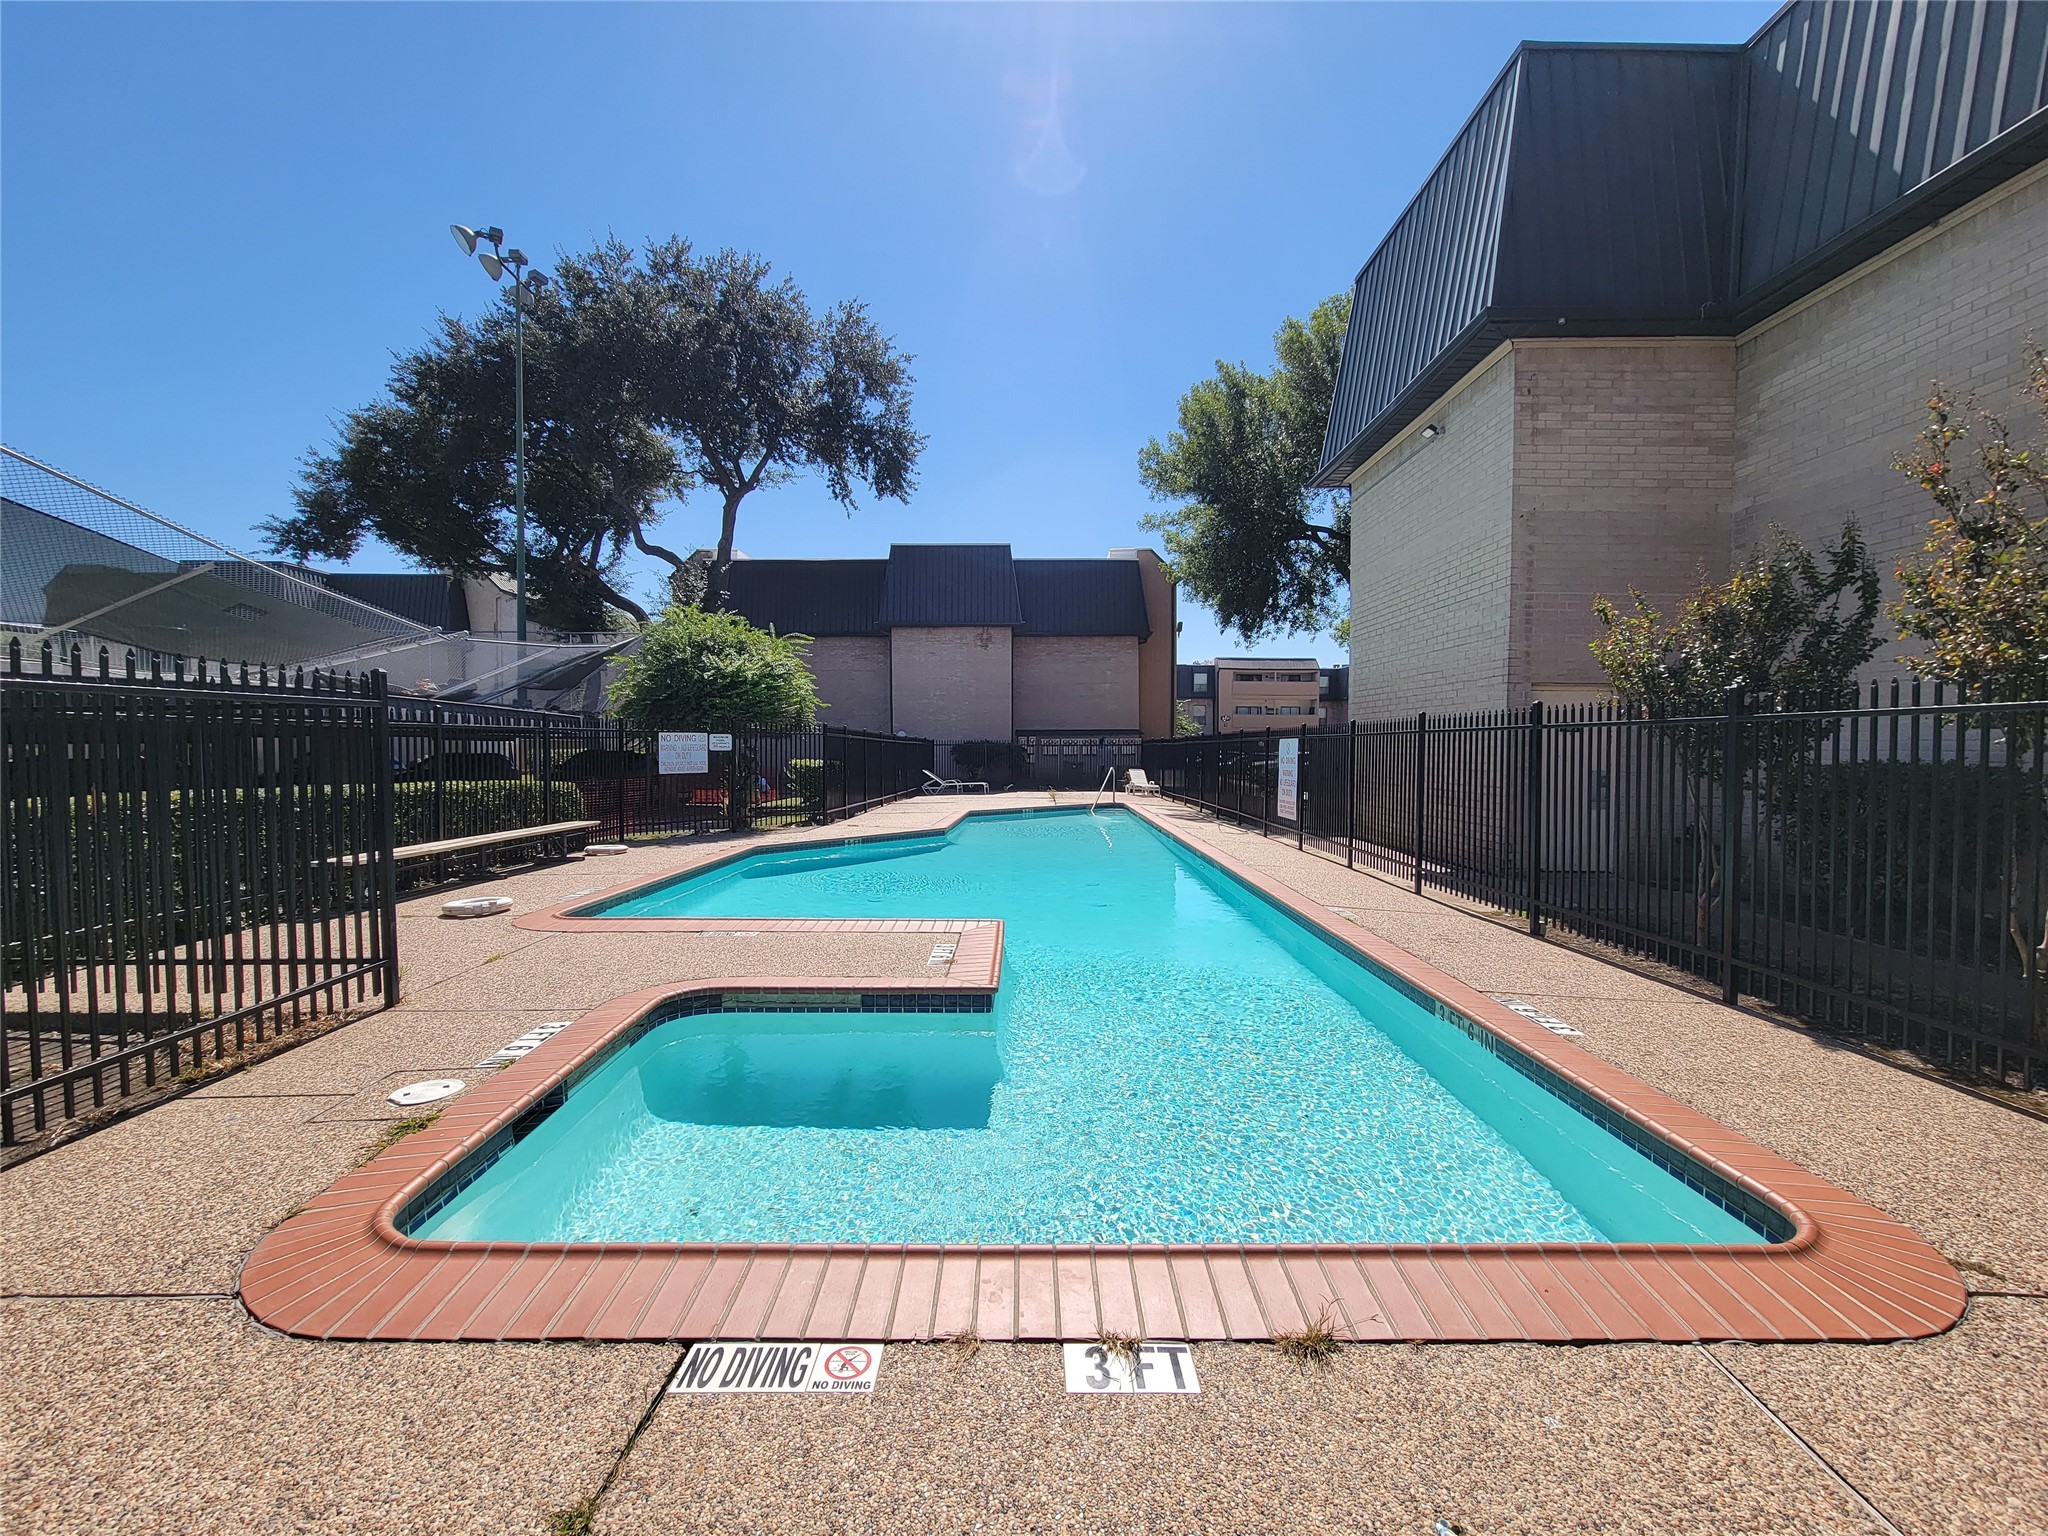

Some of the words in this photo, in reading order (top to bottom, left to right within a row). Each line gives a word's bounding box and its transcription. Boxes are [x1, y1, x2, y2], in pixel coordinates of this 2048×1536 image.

[519, 1032, 556, 1042] FT
[1480, 1030, 1494, 1054] IN
[676, 1347, 724, 1388] NO
[718, 1347, 812, 1388] DIVING
[1085, 1346, 1111, 1389] 3
[1132, 1347, 1188, 1389] FT
[811, 1381, 828, 1390] NO
[831, 1381, 871, 1390] DIVING
